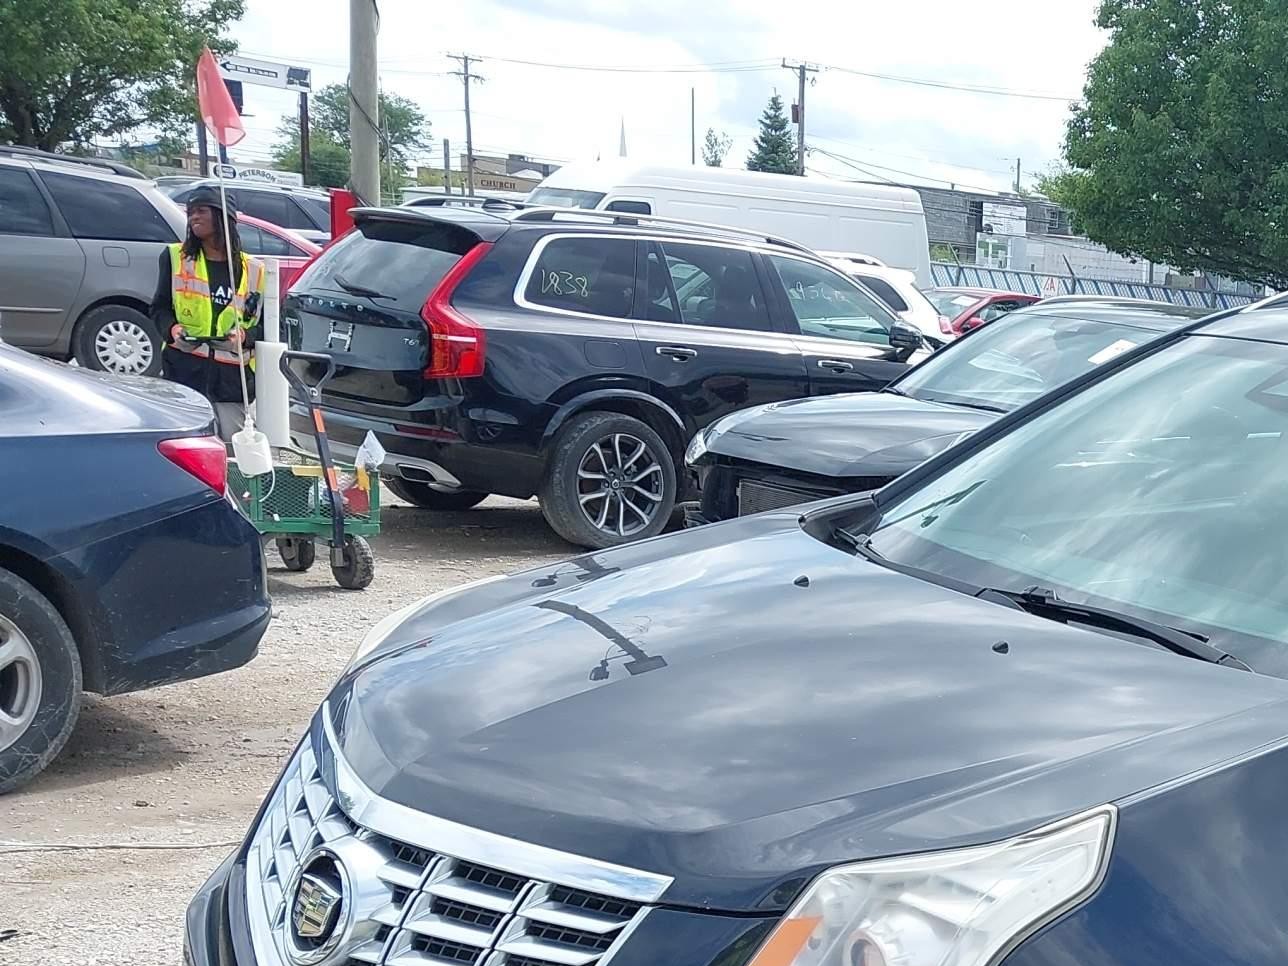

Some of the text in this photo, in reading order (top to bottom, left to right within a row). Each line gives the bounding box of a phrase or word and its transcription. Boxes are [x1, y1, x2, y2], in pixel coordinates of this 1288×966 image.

[239, 169, 276, 183] PETERSON
[481, 179, 516, 189] CHURCH
[308, 297, 364, 312] VOLVO
